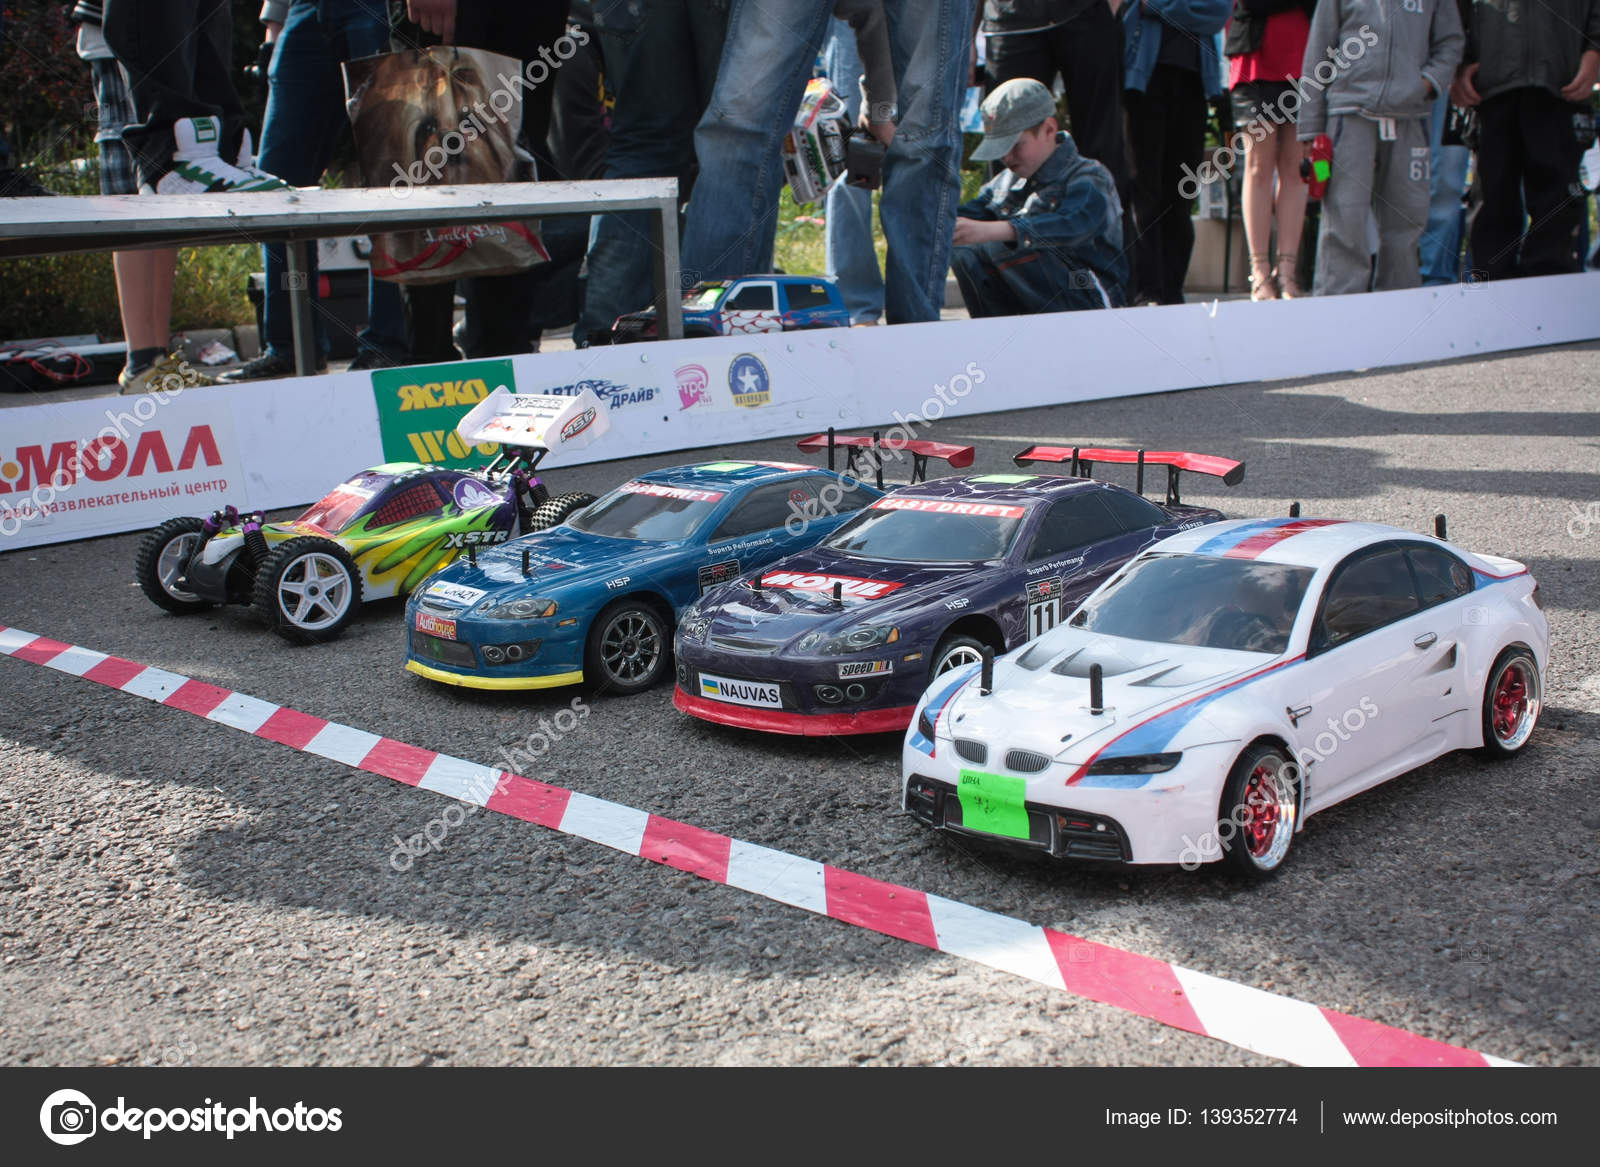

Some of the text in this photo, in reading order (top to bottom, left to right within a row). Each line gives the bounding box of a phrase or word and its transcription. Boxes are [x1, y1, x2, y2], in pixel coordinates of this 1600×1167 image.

[397, 378, 490, 412] ЯСКО
[560, 407, 597, 443] HSP
[185, 479, 228, 496] центр
[877, 499, 1016, 517] EASY DRIFT
[708, 537, 774, 555] Superb Performance
[1027, 556, 1084, 575] Superb Performance
[606, 576, 631, 590] HSP
[761, 573, 891, 597] MOTUL
[945, 598, 969, 611] HSP
[419, 615, 455, 636] Autohouse
[1033, 602, 1054, 637] 11
[719, 682, 780, 703] NAUVAS
